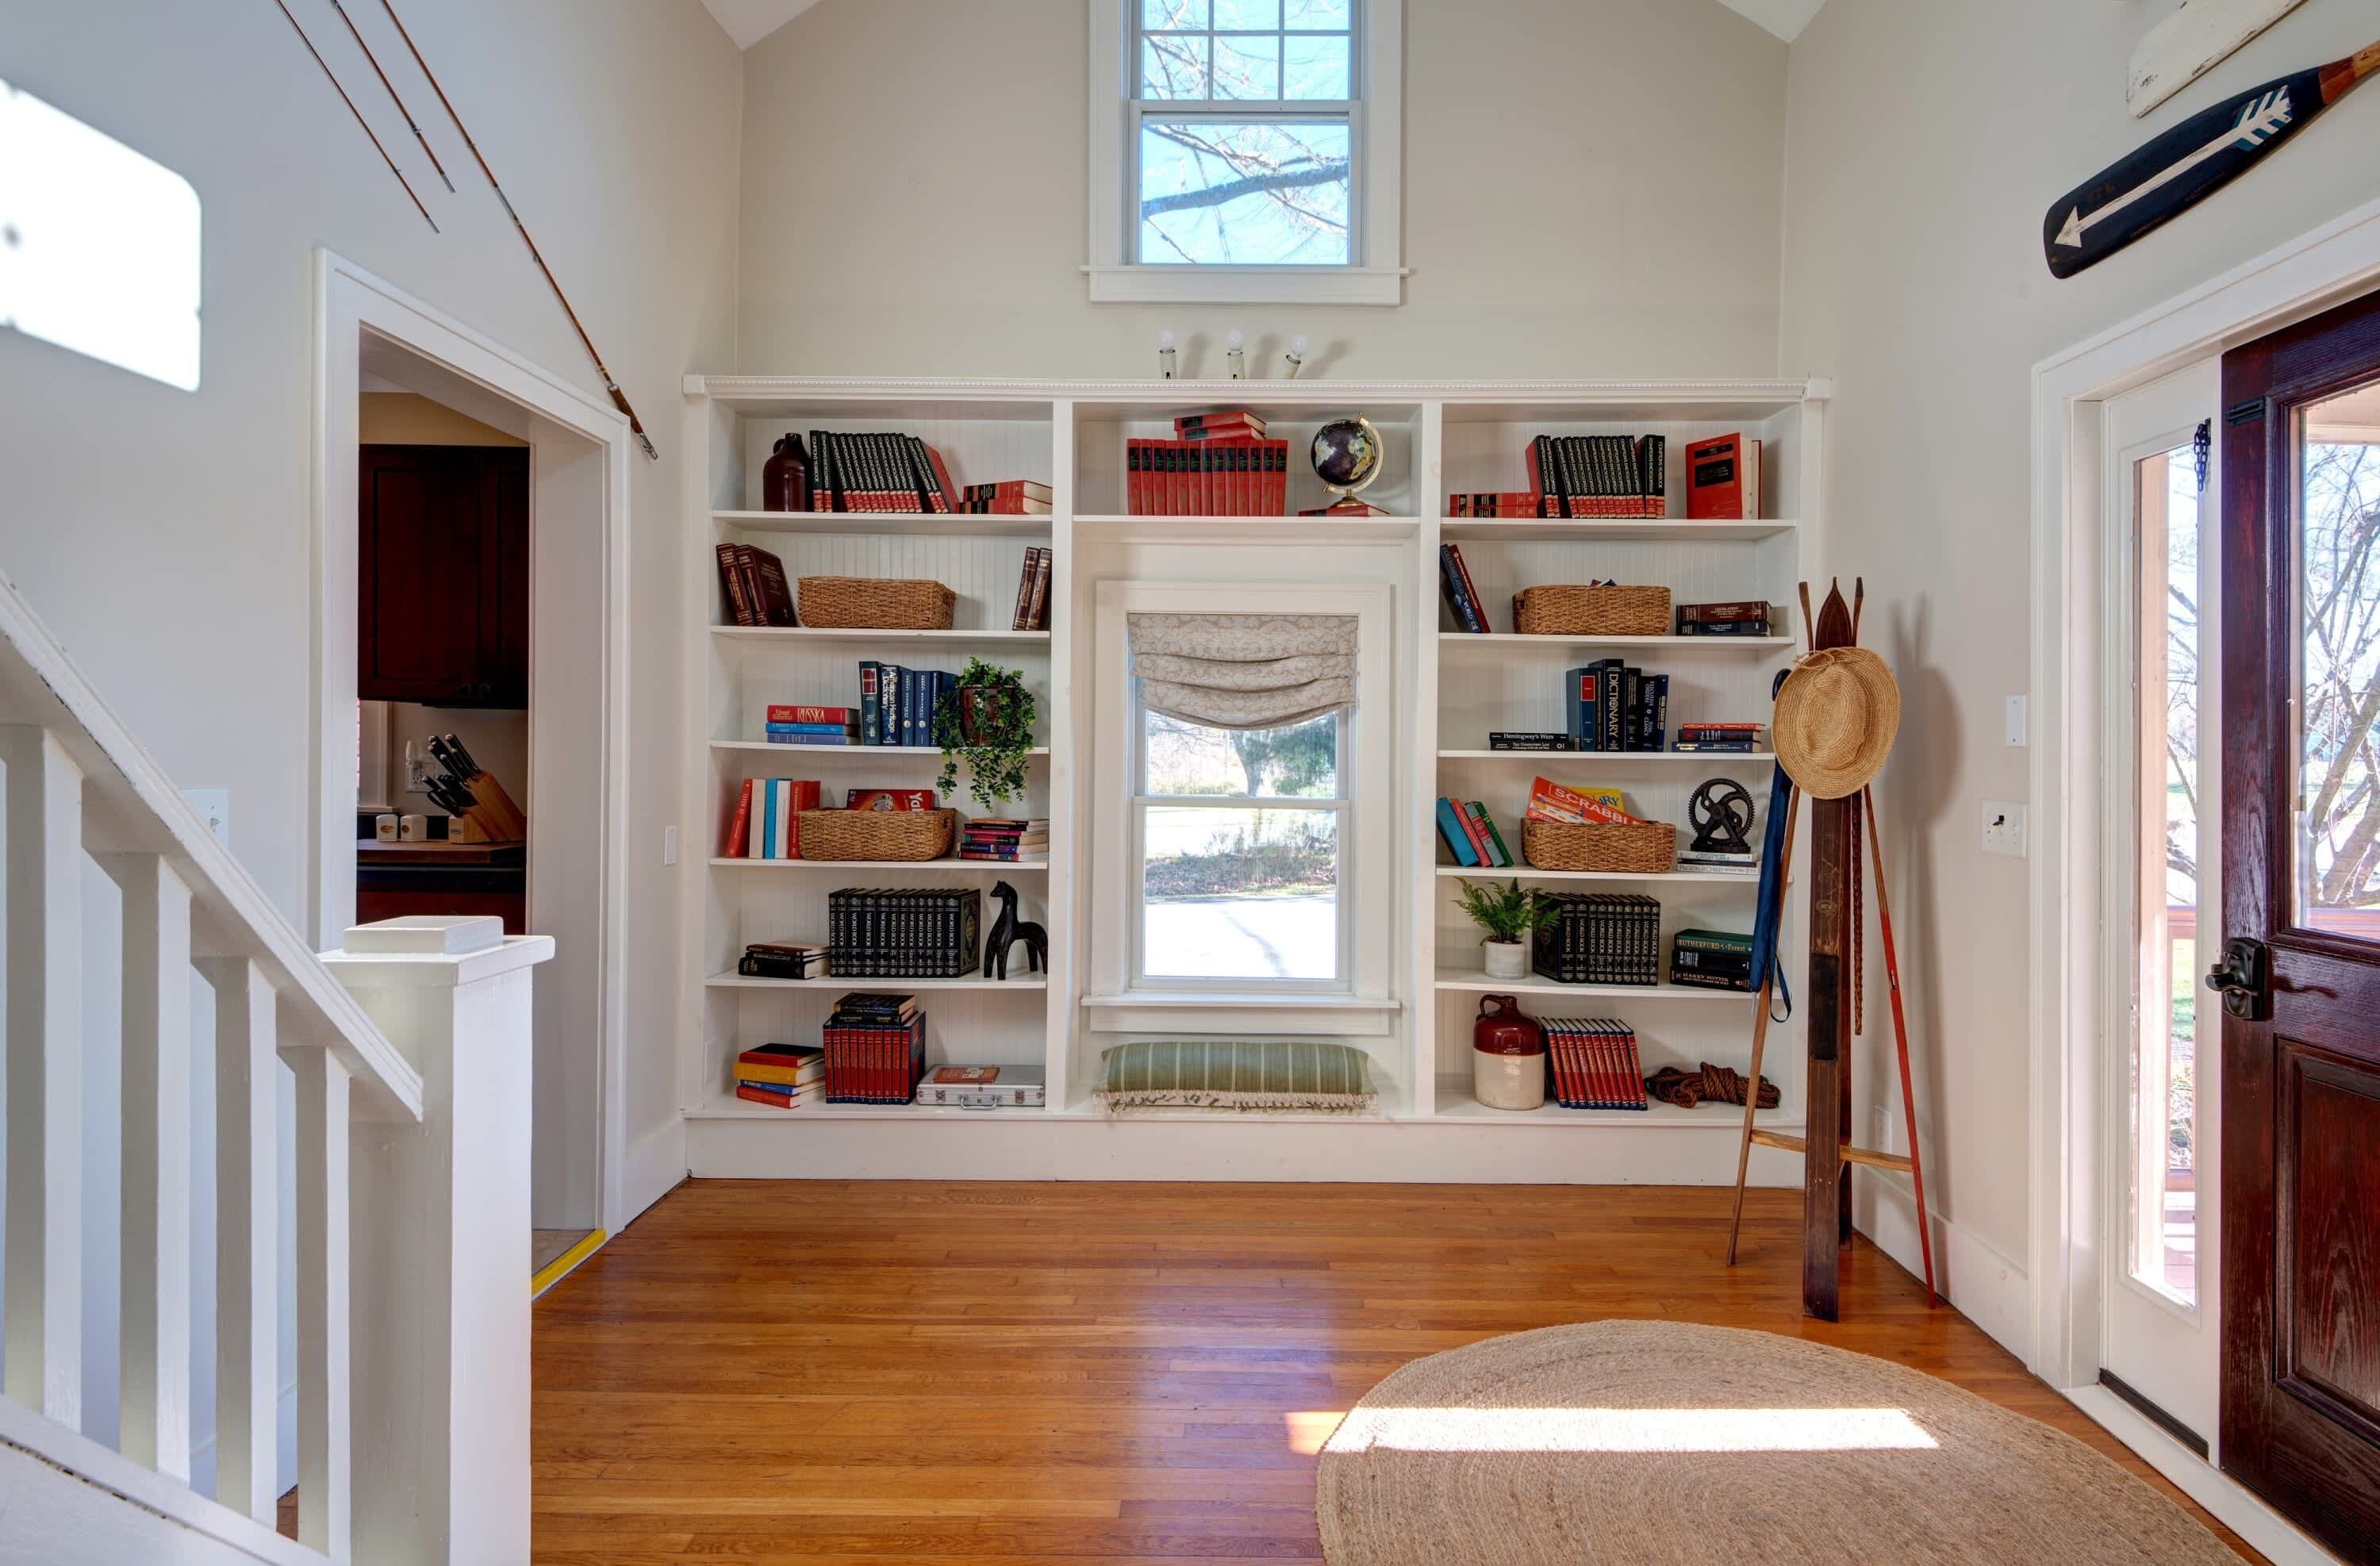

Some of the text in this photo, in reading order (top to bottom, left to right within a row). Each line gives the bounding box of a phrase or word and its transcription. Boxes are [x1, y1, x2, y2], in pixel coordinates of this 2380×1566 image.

[1464, 601, 1473, 619] WORLD
[1609, 674, 1618, 737] DICTIONARY
[798, 708, 825, 723] RUSSKA
[1679, 938, 1720, 949] RUTHERFURD
